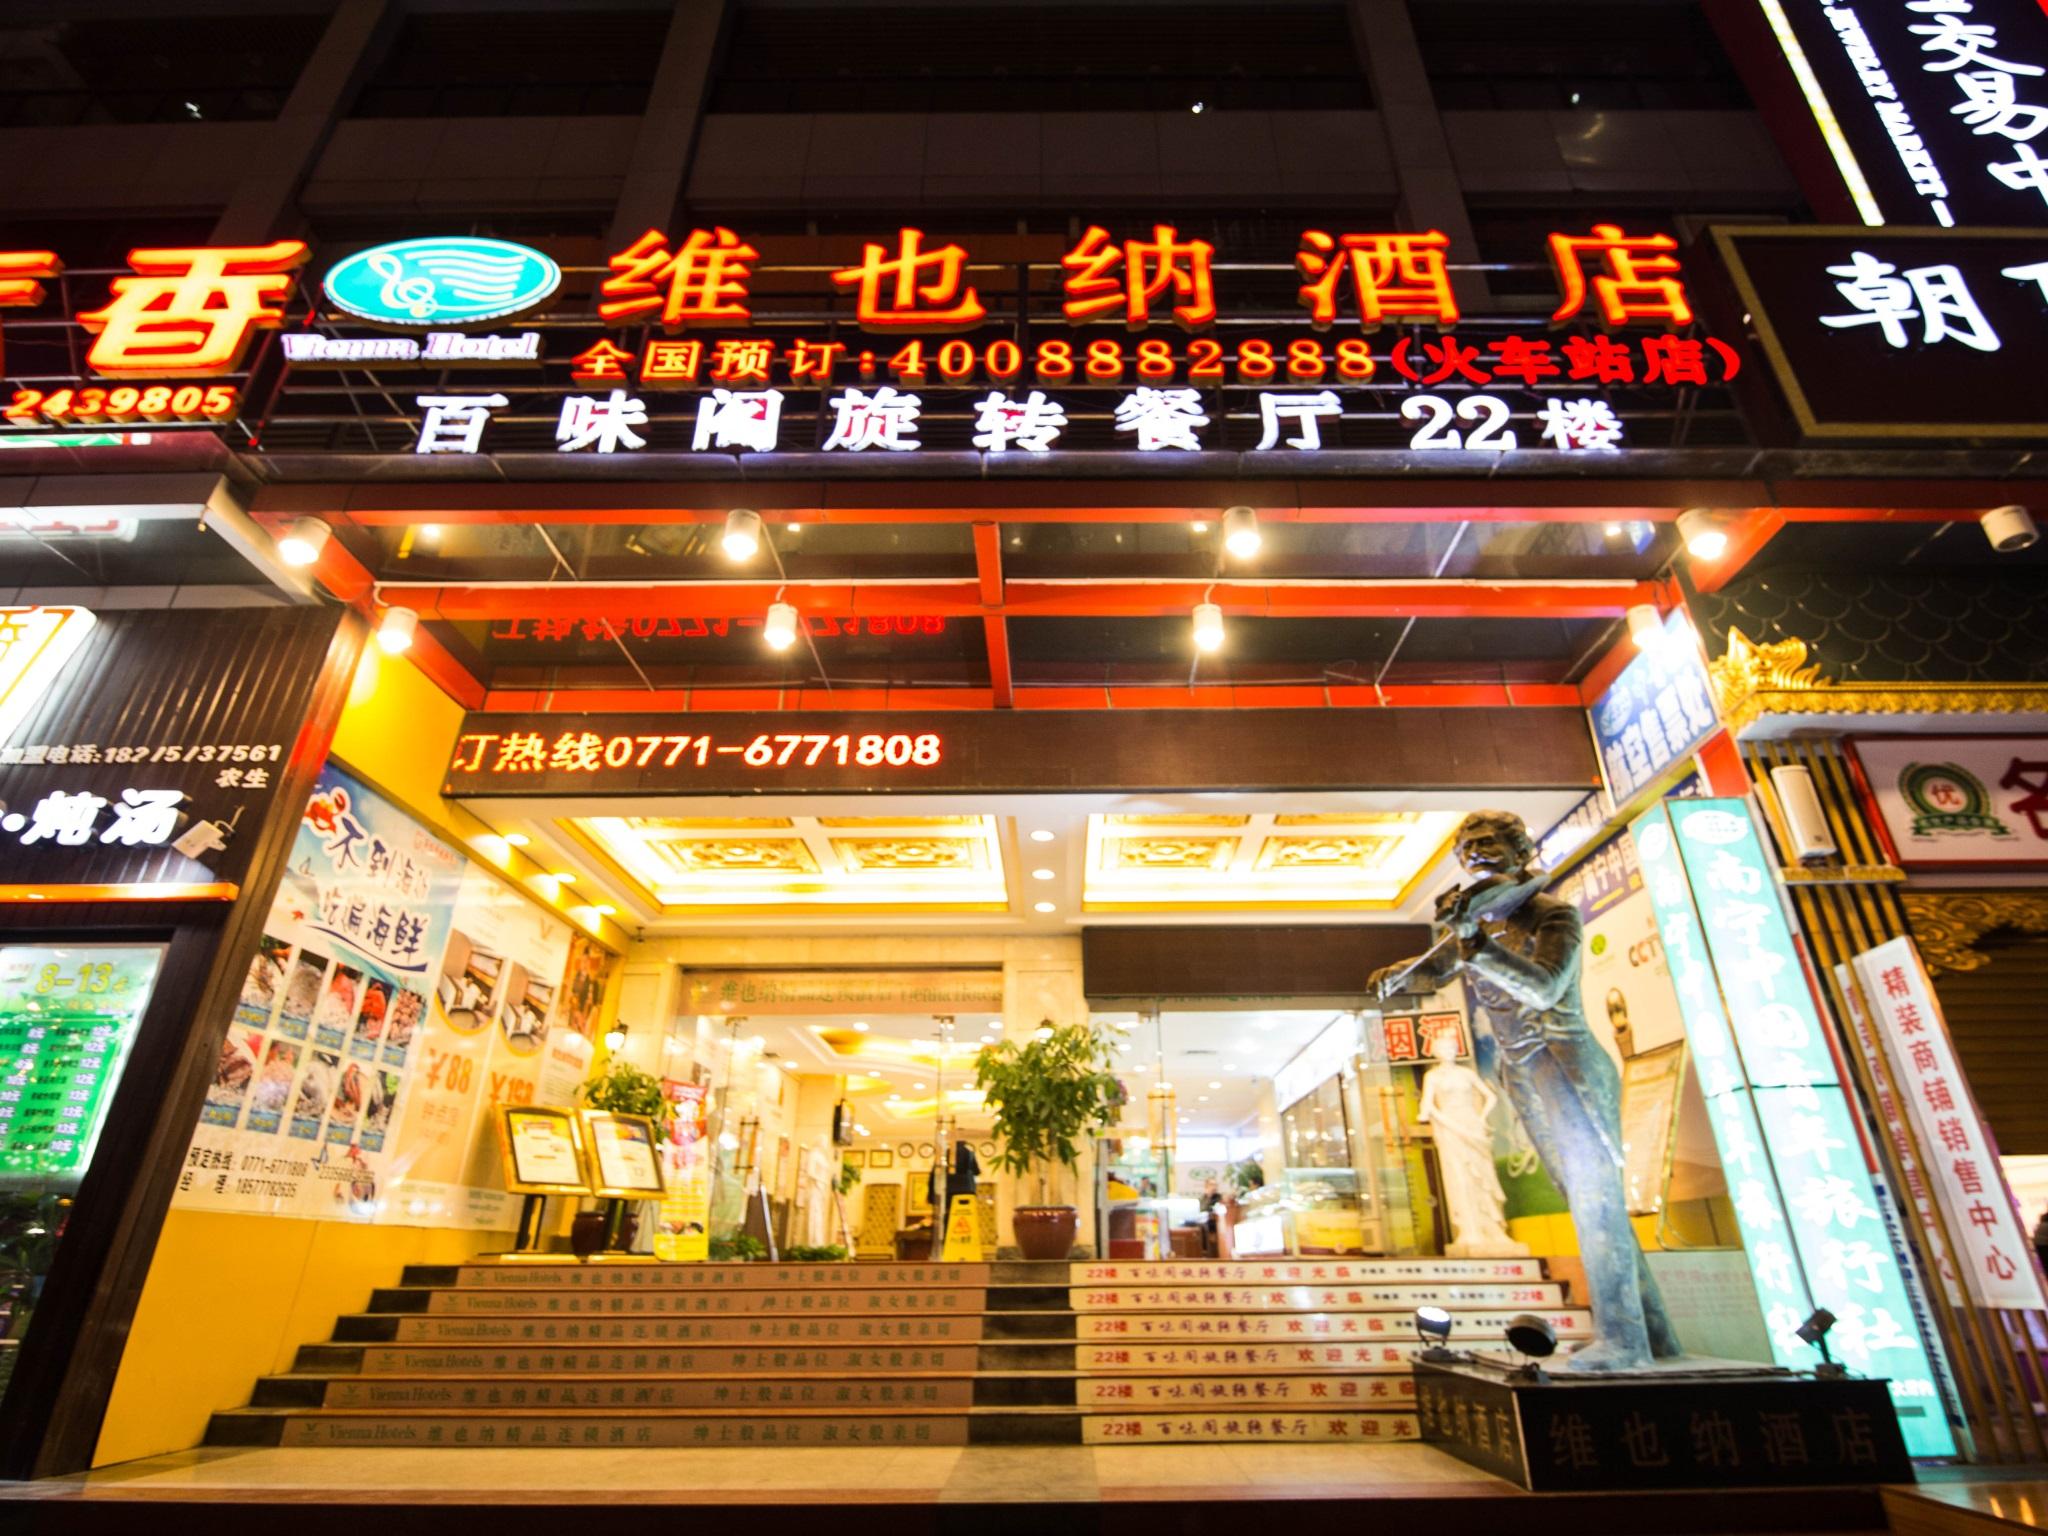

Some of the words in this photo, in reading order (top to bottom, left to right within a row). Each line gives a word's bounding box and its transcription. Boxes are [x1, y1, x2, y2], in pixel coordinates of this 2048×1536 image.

[599, 226, 1695, 326] 维也纳酒店
[0, 241, 306, 374] 香
[421, 332, 540, 360] Hotel
[4, 386, 237, 418] 2439805
[215, 767, 269, 789] 农生
[1706, 849, 1918, 1358] 南宁中国青年旅行社
[1087, 1268, 1118, 1279] 22楼
[1262, 1265, 1351, 1279] 欢迎光临
[1087, 1293, 1119, 1305] 22楼
[1094, 1320, 1129, 1333] 22楼
[1287, 1318, 1385, 1333] 欢迎光临
[1093, 1350, 1131, 1363] 22楼
[1297, 1348, 1400, 1363] 欢迎光临
[1096, 1385, 1134, 1398] 22楼
[1310, 1381, 1416, 1397] 欢迎光临
[1103, 1420, 1143, 1436] 22楼
[1328, 1418, 1412, 1436] 欢迎光
[1549, 1407, 1879, 1469] 维也纳酒店
